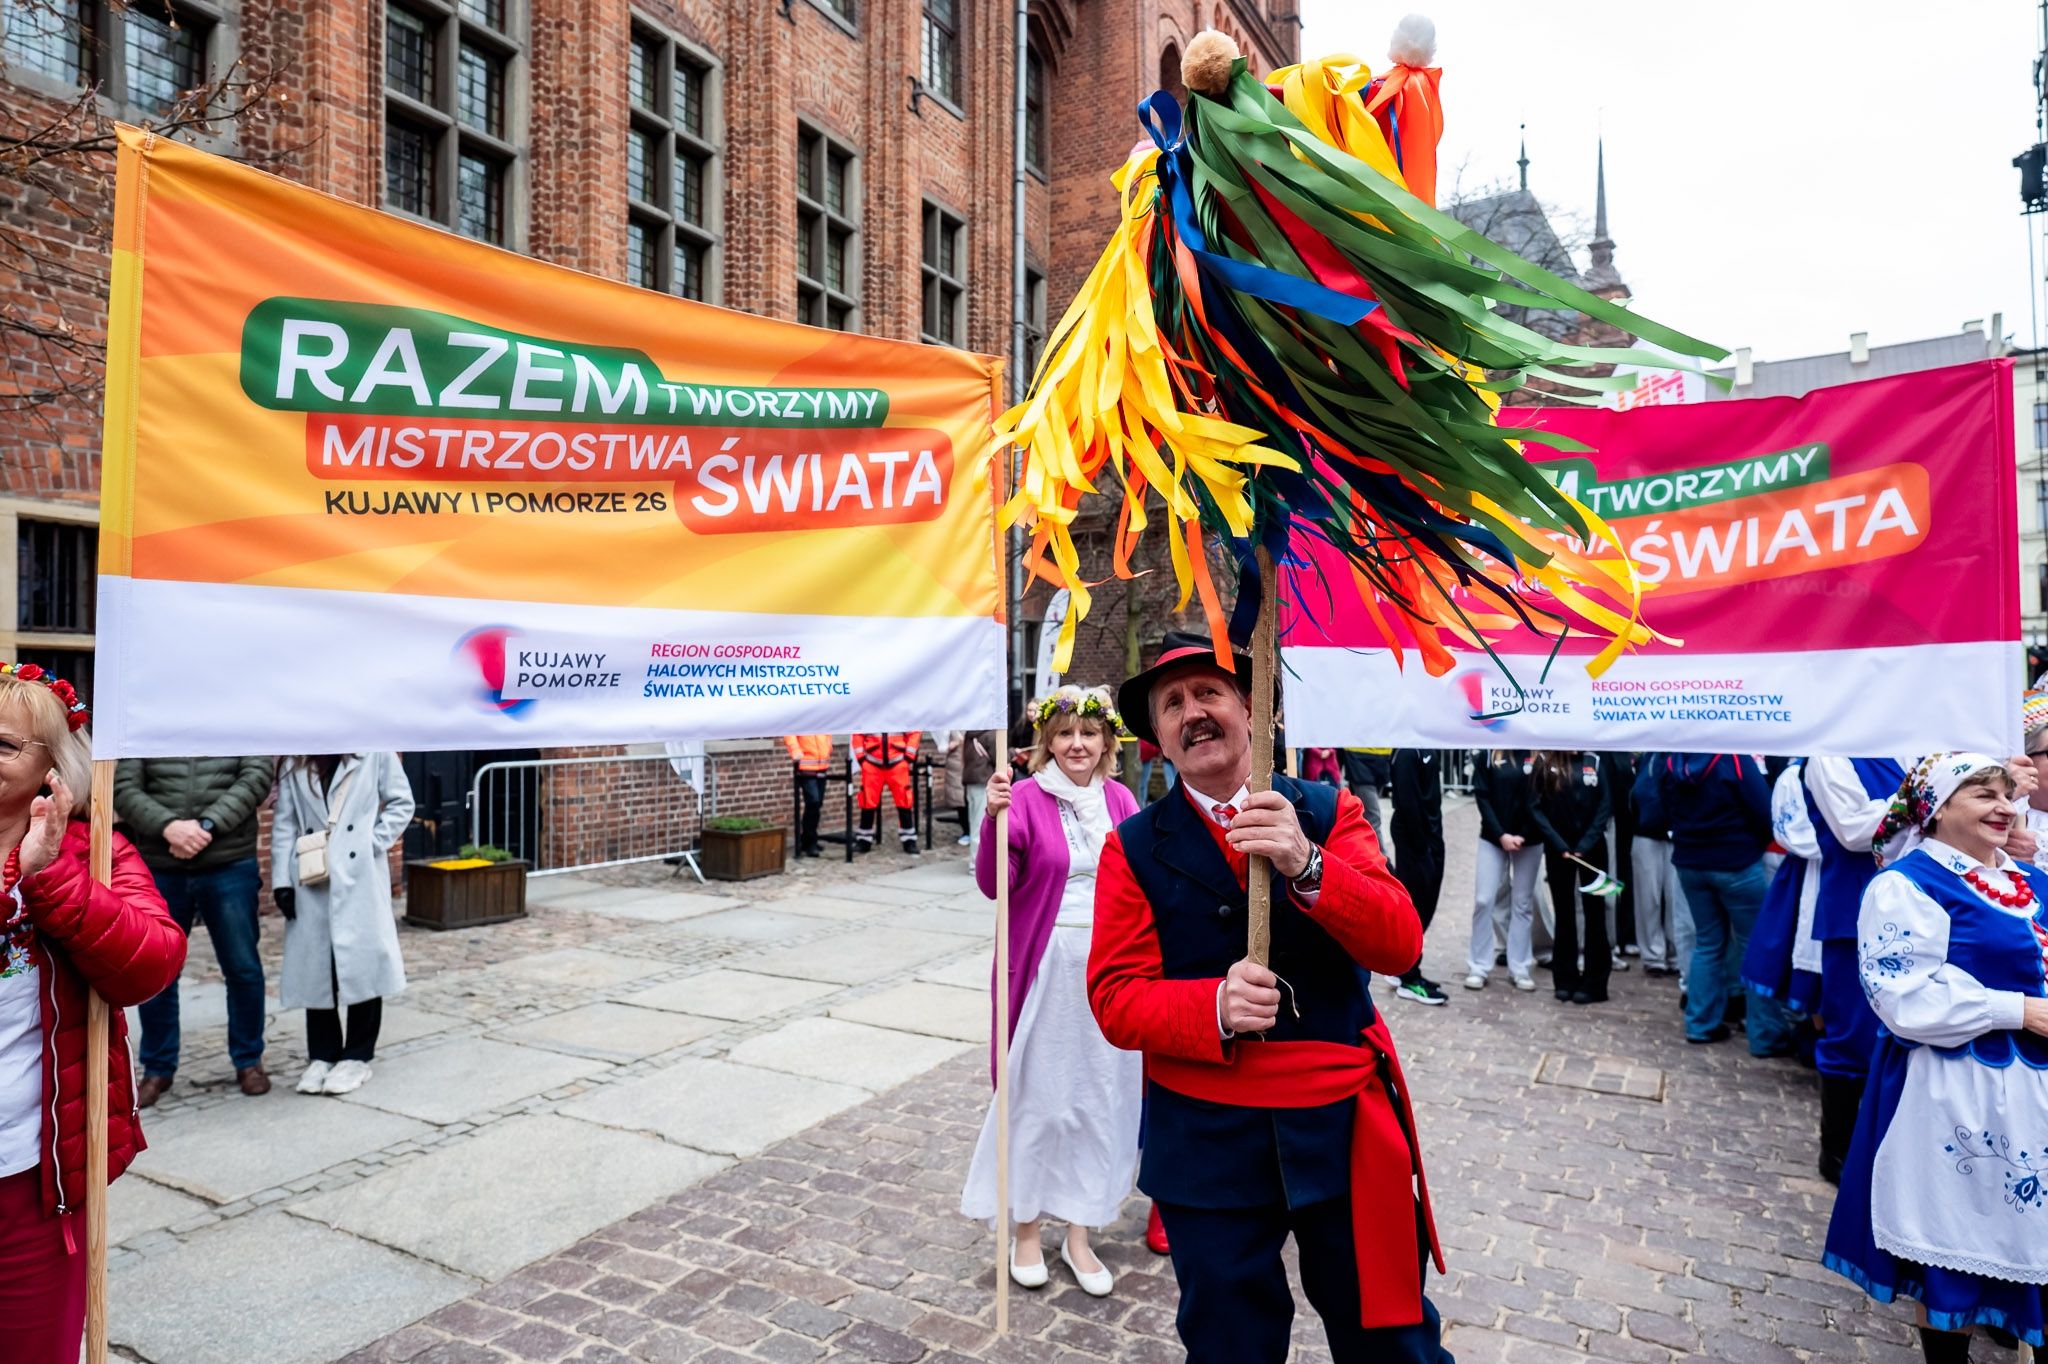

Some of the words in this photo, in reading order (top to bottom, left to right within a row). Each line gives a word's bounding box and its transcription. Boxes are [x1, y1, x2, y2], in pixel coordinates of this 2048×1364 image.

[275, 318, 649, 415] RAZEM
[657, 382, 879, 419] TWORZYMY
[322, 424, 693, 470] MISTRZOSTWA
[691, 437, 942, 517] ŚWIATA
[1586, 447, 1819, 514] TWORZYMY
[325, 490, 462, 514] KUJAWY
[471, 492, 480, 513] I
[485, 492, 627, 513] POMORZE
[633, 491, 667, 512] 26
[1629, 487, 1920, 583] ŚWIATA
[651, 643, 710, 658] REGION
[713, 645, 801, 659] GOSPODARZ
[519, 651, 606, 668] KUJAWY
[647, 664, 736, 678] HALOWYCH
[740, 665, 840, 678] MISTRZOSTW
[517, 673, 621, 688] POMORZE
[1591, 681, 1646, 692] REGION
[1650, 680, 1743, 691] GOSPODARZ
[643, 680, 705, 698] ŚWIATA
[707, 685, 724, 697] W
[729, 682, 851, 696] LEKKOATLETYCE
[1491, 687, 1554, 699] KUJAWY
[1592, 696, 1677, 706] HALOWYCH
[1681, 694, 1784, 706] MISTRZOSTW
[1593, 708, 1647, 721] ŚWIATA
[1650, 710, 1666, 720] W
[1670, 709, 1792, 722] LEKKOATLETYCE
